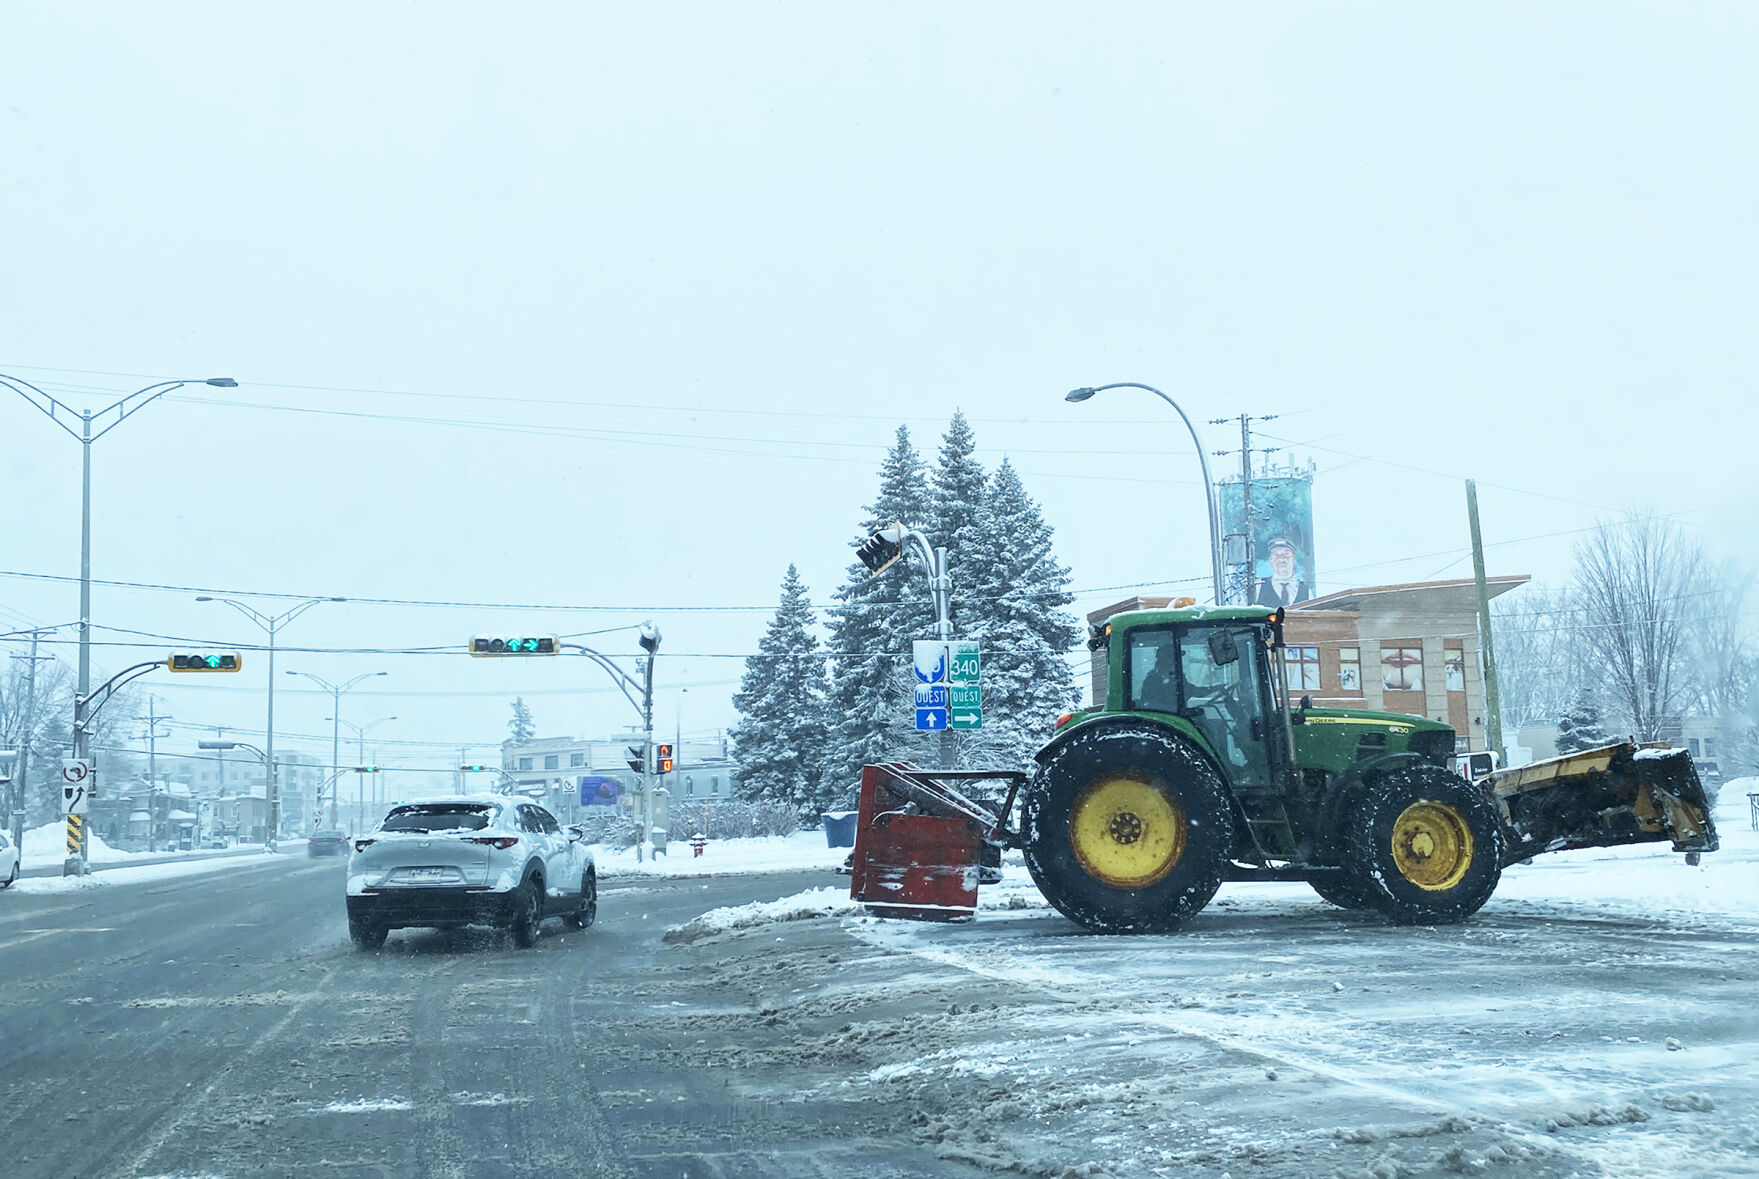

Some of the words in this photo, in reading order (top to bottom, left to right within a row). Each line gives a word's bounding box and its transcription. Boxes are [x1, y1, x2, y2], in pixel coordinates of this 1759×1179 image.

[951, 659, 978, 676] 340
[916, 690, 945, 703] OUEST
[953, 690, 978, 703] OUEST
